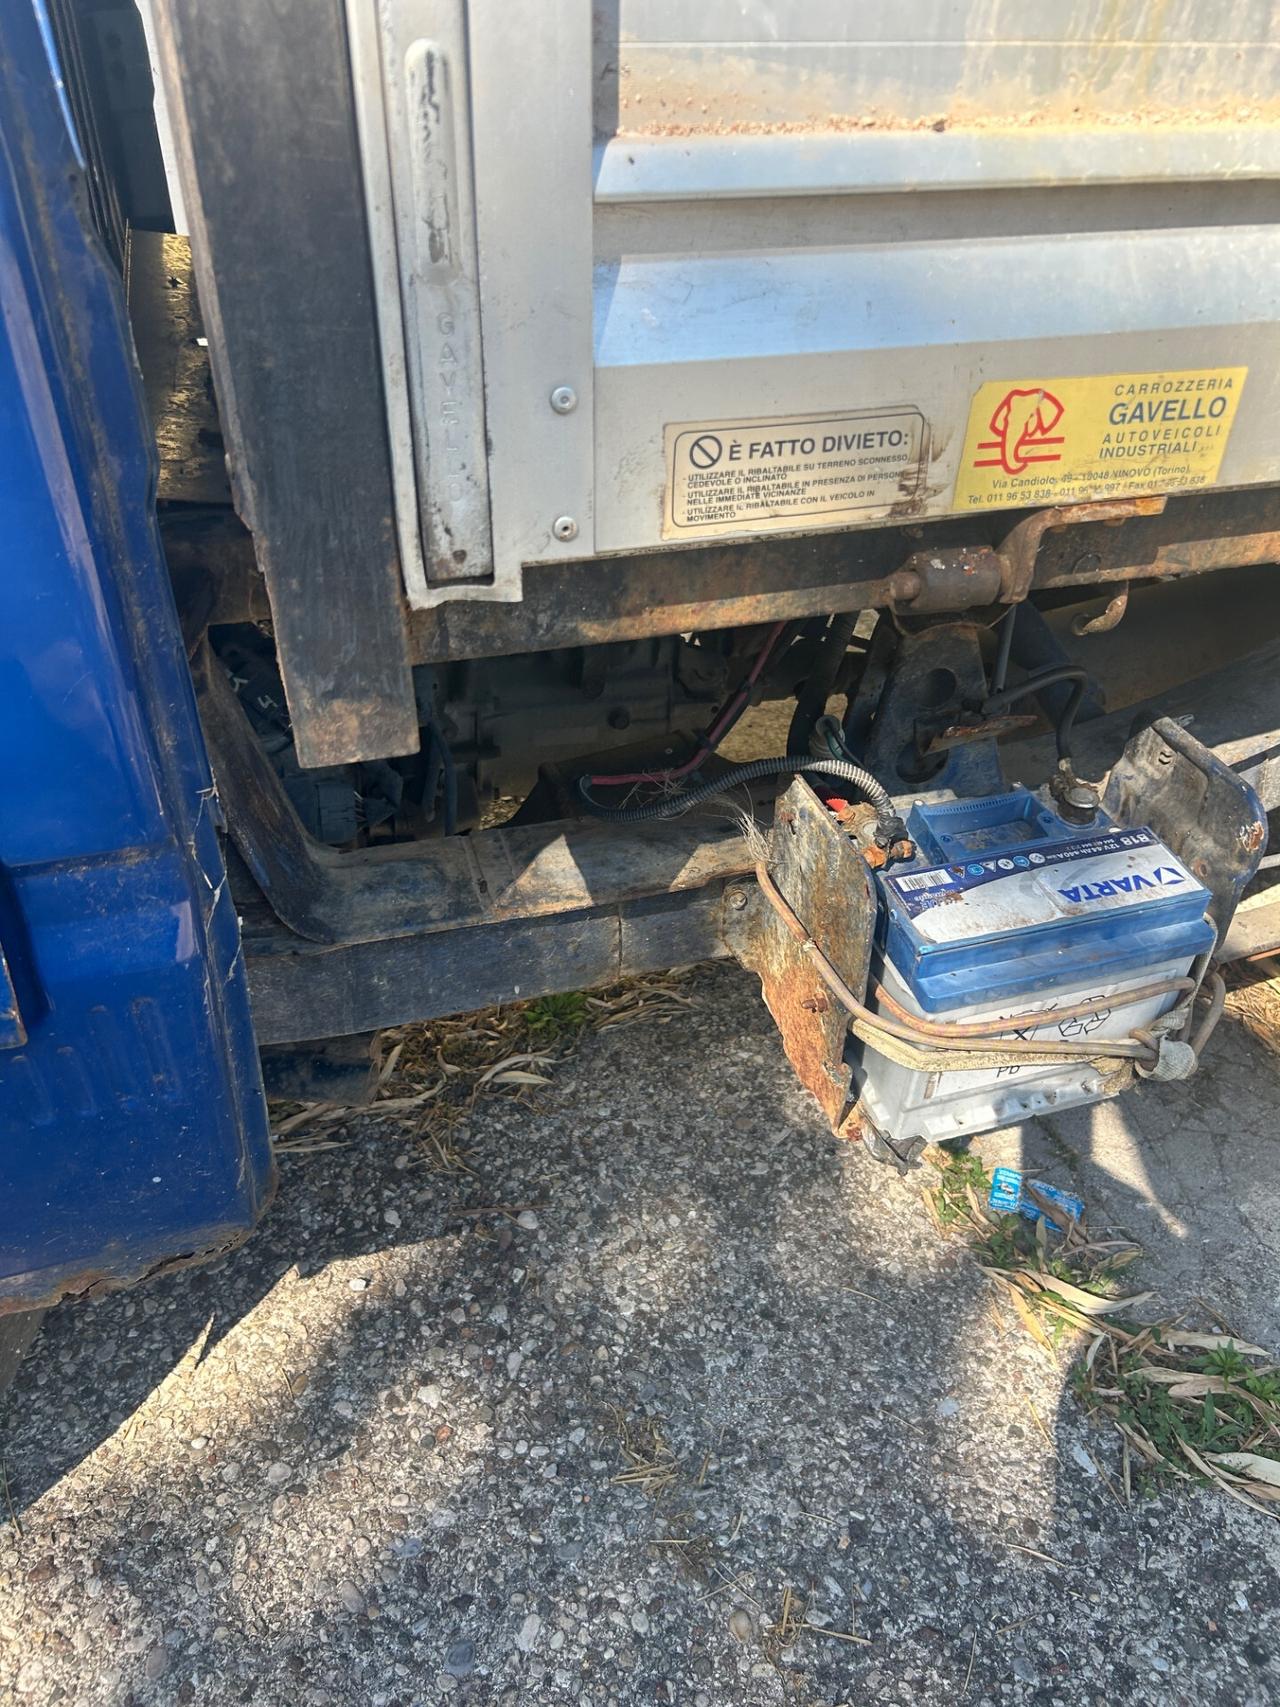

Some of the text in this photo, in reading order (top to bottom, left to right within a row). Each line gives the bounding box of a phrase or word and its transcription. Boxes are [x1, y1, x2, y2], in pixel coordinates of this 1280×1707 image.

[1114, 378, 1233, 396] CARROZZERIA
[1108, 396, 1227, 425] GAVELLO
[1102, 425, 1221, 445] AUTOVEICOLI
[729, 430, 909, 461] È FATTO DIVIETO:
[1099, 441, 1197, 459] INDUSTRIALI
[687, 470, 736, 482] UTILIZZARE
[738, 470, 746, 478] IL
[747, 464, 803, 476] RIBALTABILE
[803, 463, 815, 471] SU
[817, 459, 857, 469] TERRENO
[687, 478, 732, 489] CEDEVOLE
[742, 473, 788, 484] INCLINATO
[687, 488, 735, 499] UTILIZZARE
[746, 481, 800, 493] RIBALTABILE
[812, 475, 856, 486] PRESENZA
[992, 480, 1008, 489] Via
[687, 488, 807, 506] NELLE IMMEDIATE VICINANZE
[687, 504, 734, 516] UTILIZZARE
[745, 498, 798, 510] RIBALTABILE
[800, 496, 818, 505] CON
[820, 495, 828, 503] IL
[829, 491, 865, 502] VEICOLO
[968, 495, 983, 504] Tel.
[986, 493, 1003, 503] 011
[1006, 491, 1018, 502] 96
[1020, 490, 1032, 500] 53
[1034, 488, 1052, 499] 838
[687, 512, 736, 522] MOVIMENTO
[1119, 833, 1150, 846] B18
[1057, 874, 1157, 904] VARTA
